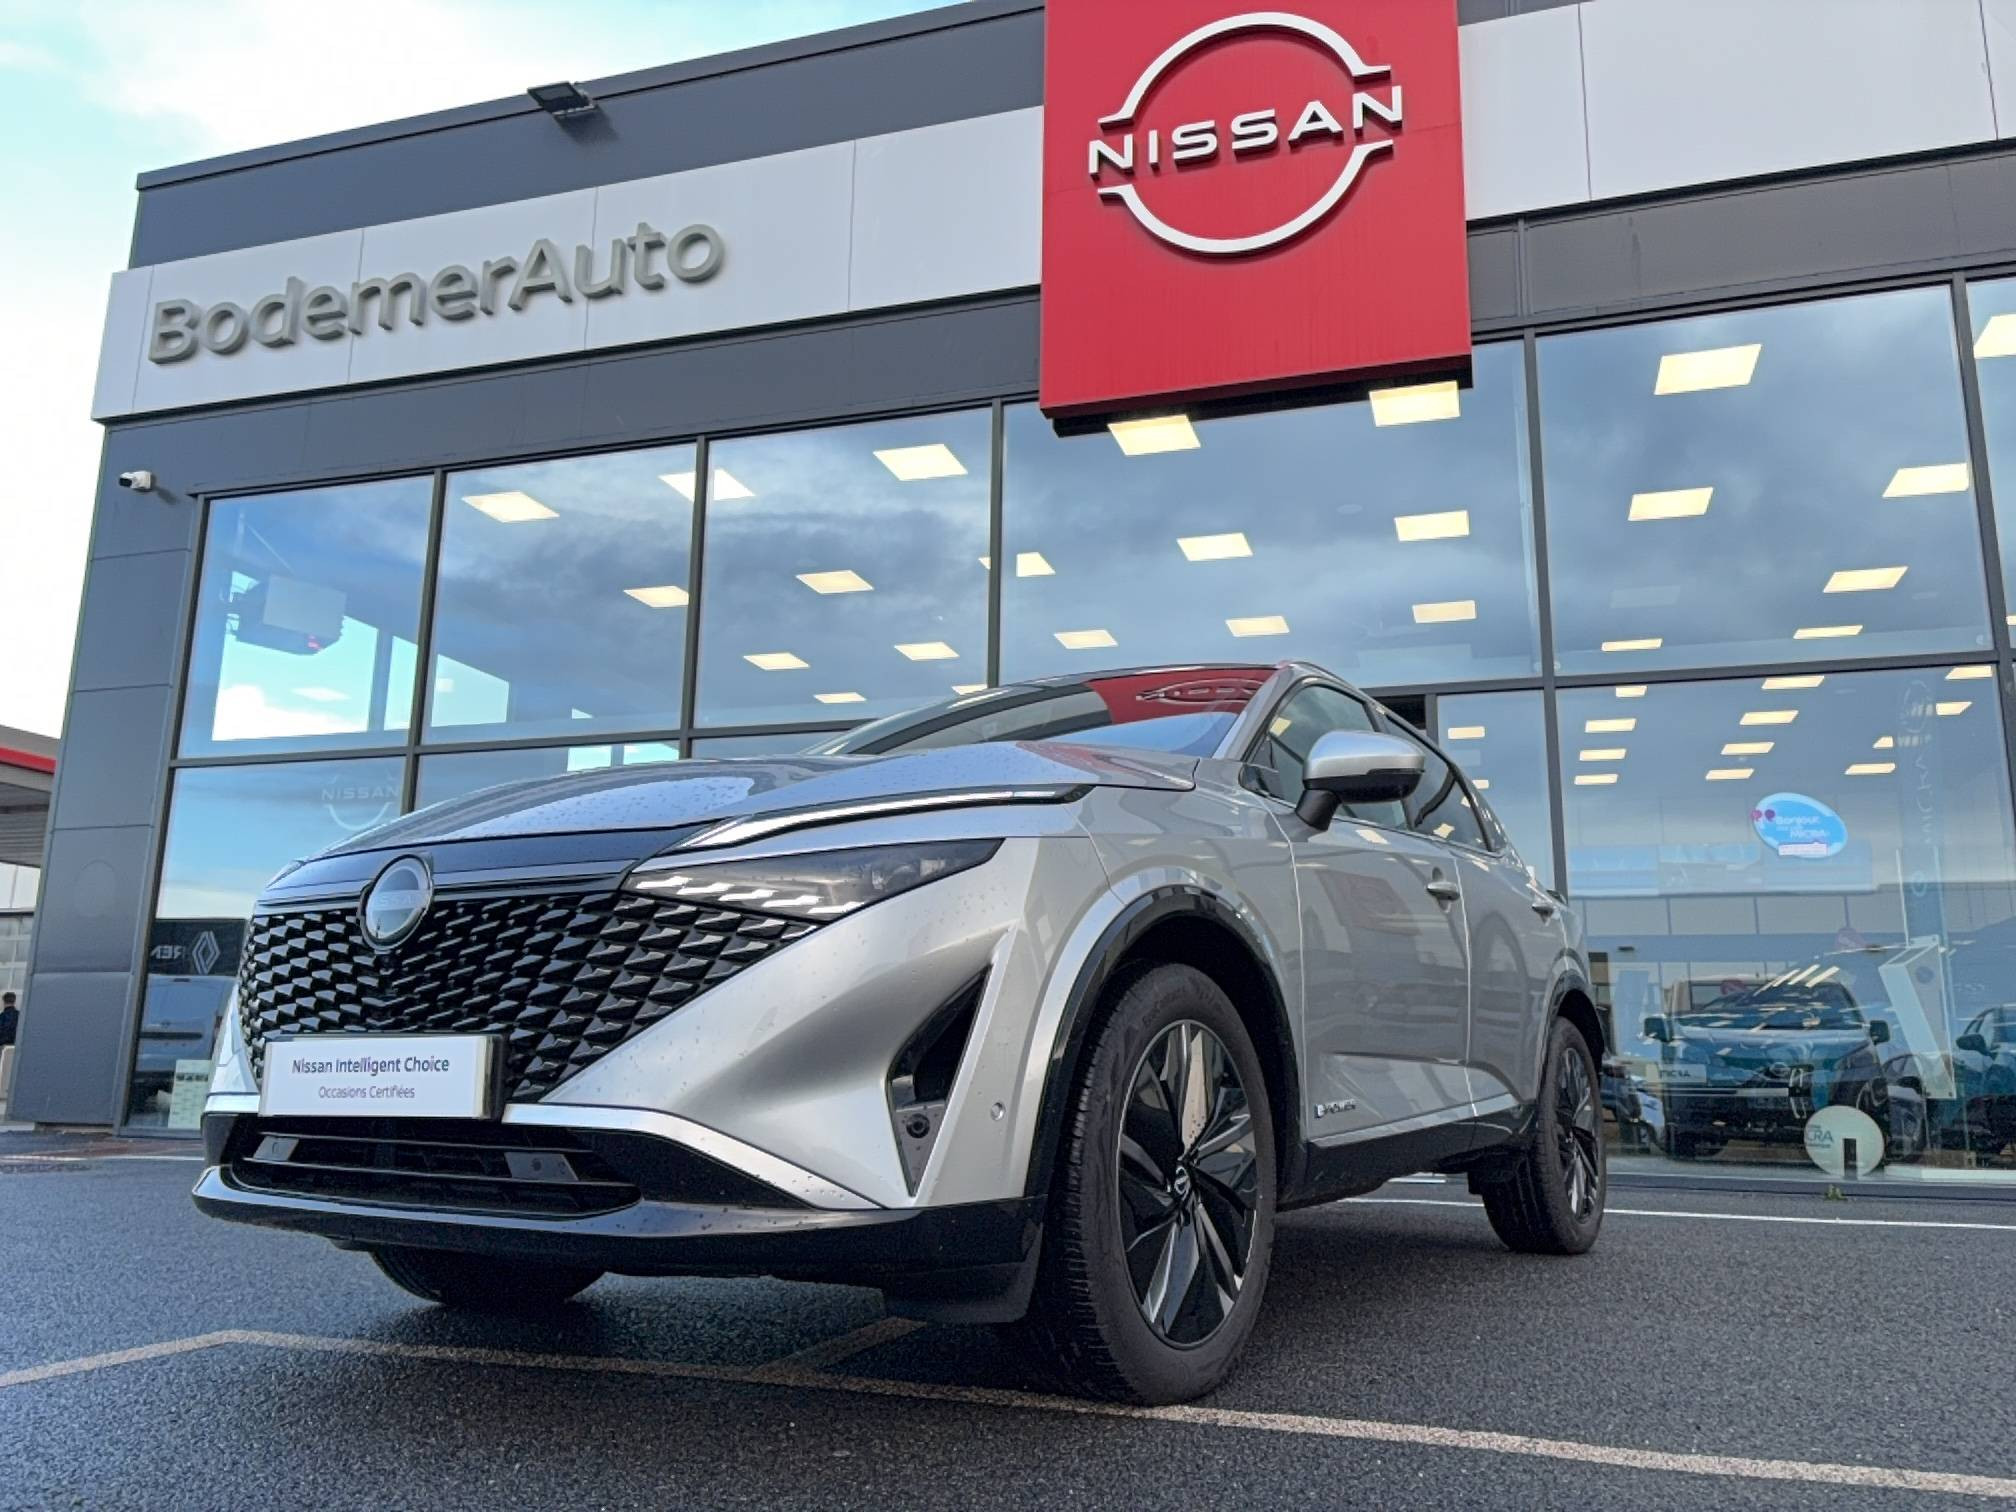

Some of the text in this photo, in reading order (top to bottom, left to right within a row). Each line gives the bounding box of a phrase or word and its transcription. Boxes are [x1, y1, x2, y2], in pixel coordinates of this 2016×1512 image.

[1088, 85, 1403, 178] NISSAN
[149, 221, 727, 365] BodemerAuto
[321, 784, 399, 801] NISSAN
[292, 1055, 450, 1077] Nissan Intelligent Choice
[318, 1084, 415, 1099] Occasions Certifiées
